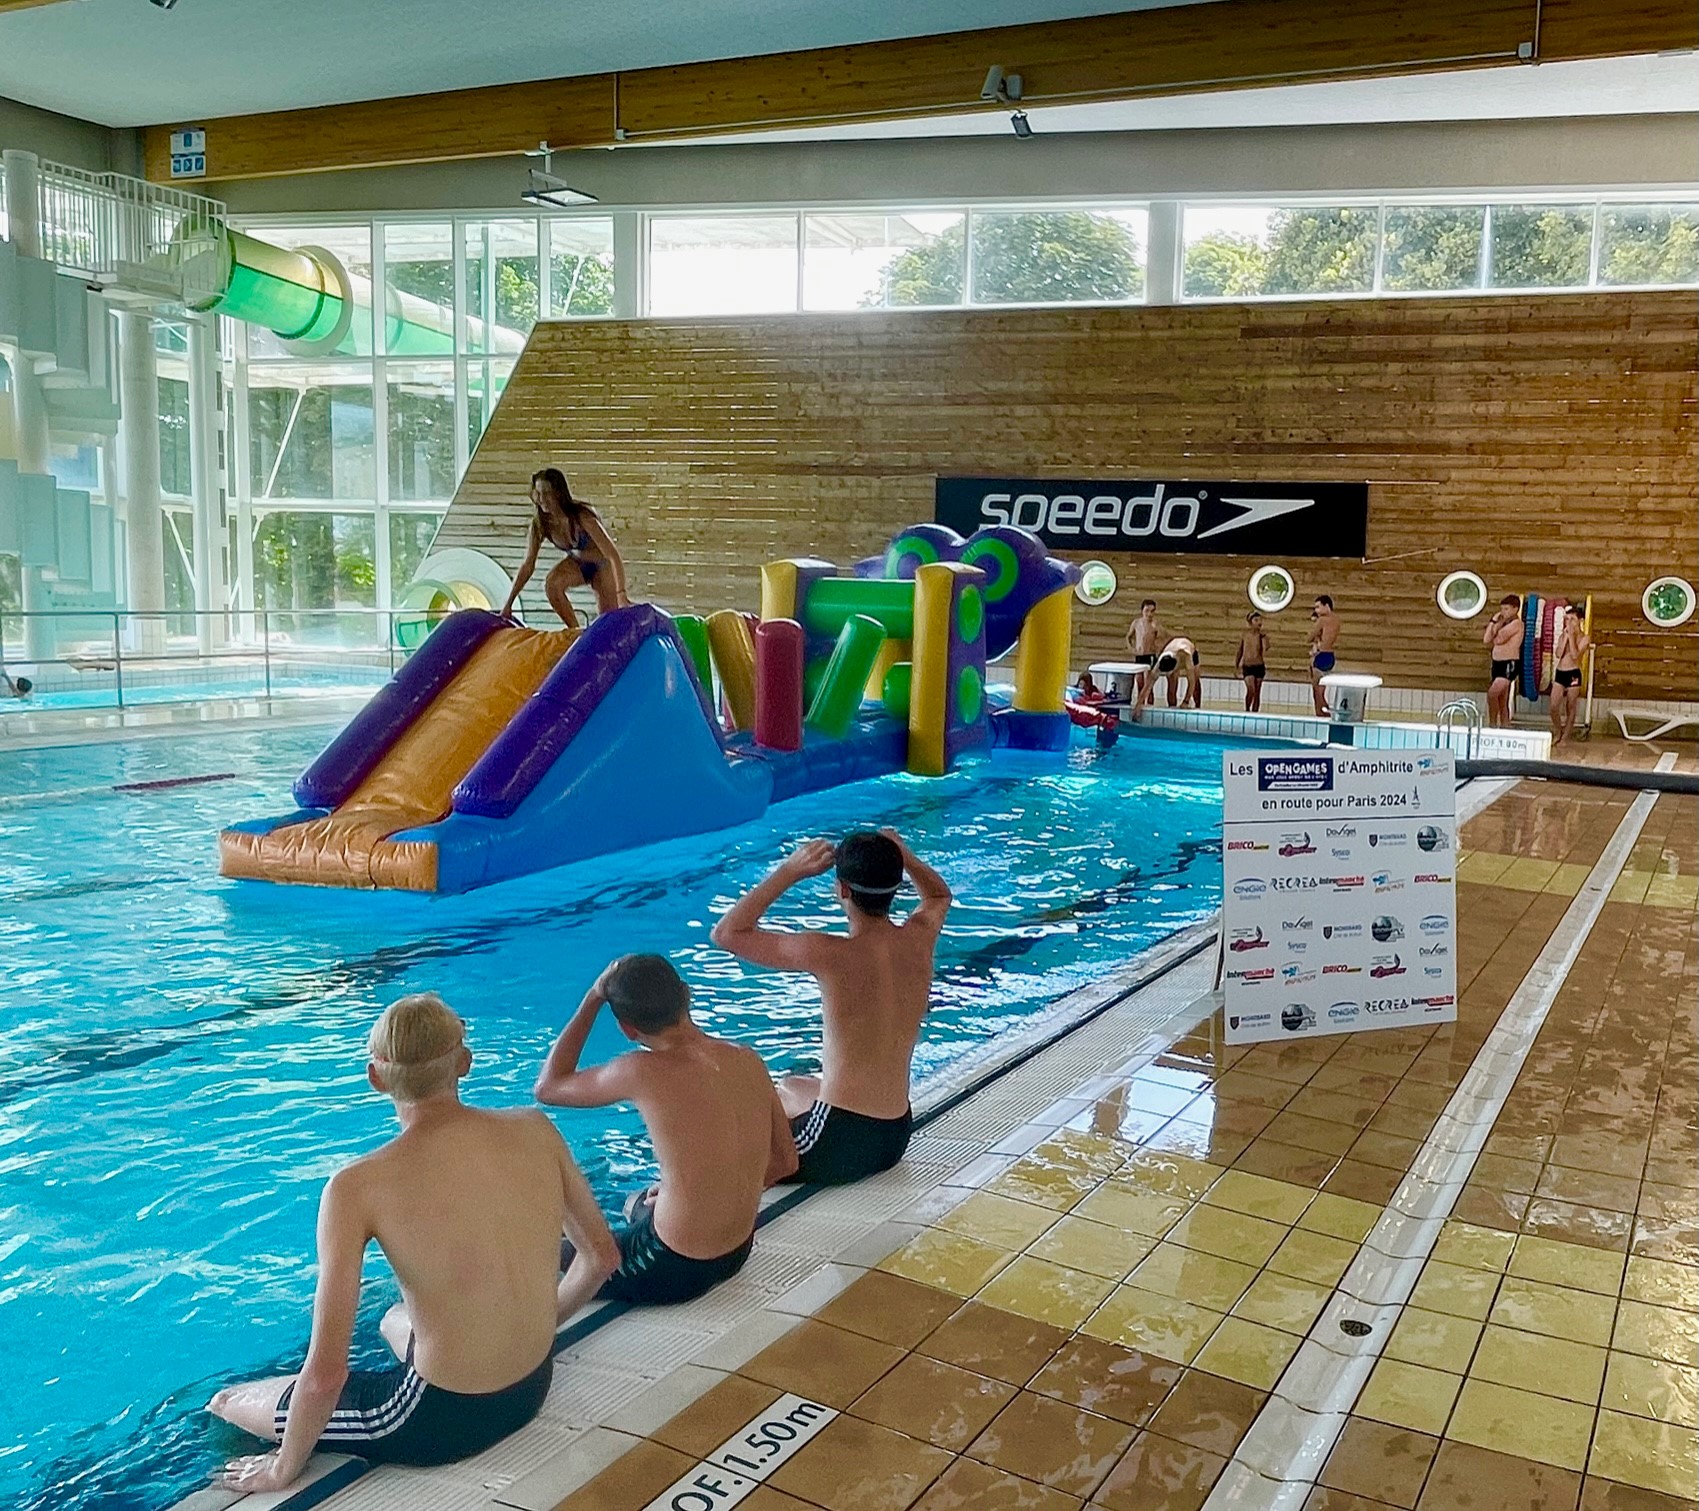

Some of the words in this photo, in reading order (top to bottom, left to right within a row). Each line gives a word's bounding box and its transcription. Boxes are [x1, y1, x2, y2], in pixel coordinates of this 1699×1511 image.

[979, 484, 1200, 537] speedo
[1340, 697, 1348, 711] 4
[1229, 762, 1253, 776] Les
[1338, 760, 1413, 776] d'Amphitrite
[1262, 799, 1277, 810] en
[1281, 797, 1313, 810] route
[1316, 797, 1344, 812] pour
[1347, 794, 1377, 808] Paris
[1380, 793, 1407, 807] 2024
[723, 1402, 826, 1470] 1.50m
